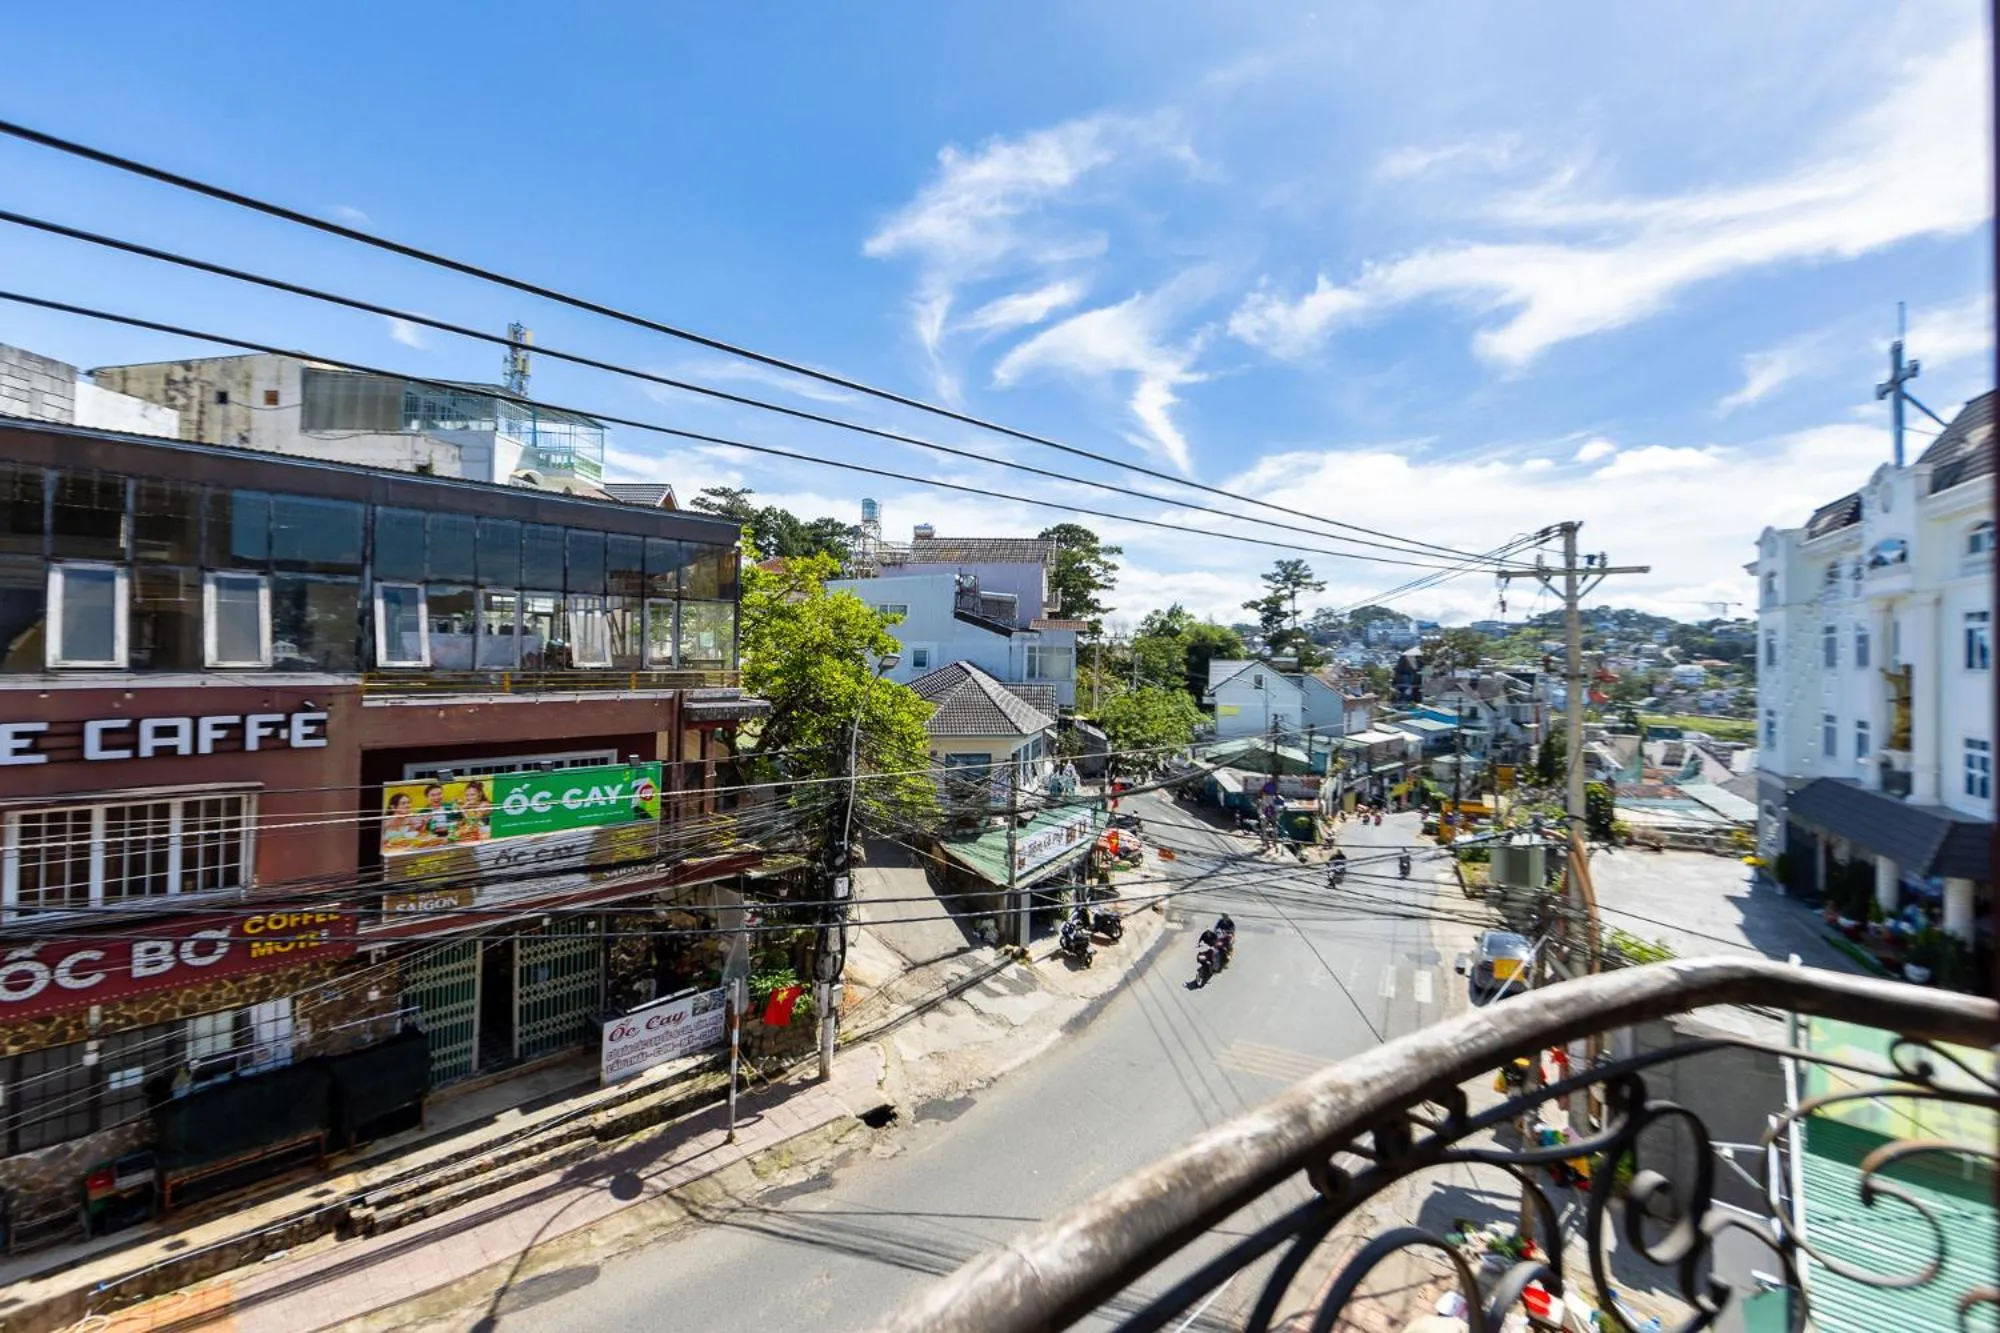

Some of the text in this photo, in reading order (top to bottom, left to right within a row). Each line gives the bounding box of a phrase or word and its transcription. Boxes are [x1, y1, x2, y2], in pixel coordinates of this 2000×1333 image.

[503, 783, 623, 816] ỐC CAY
[0, 925, 233, 1002] ỐC BƠ
